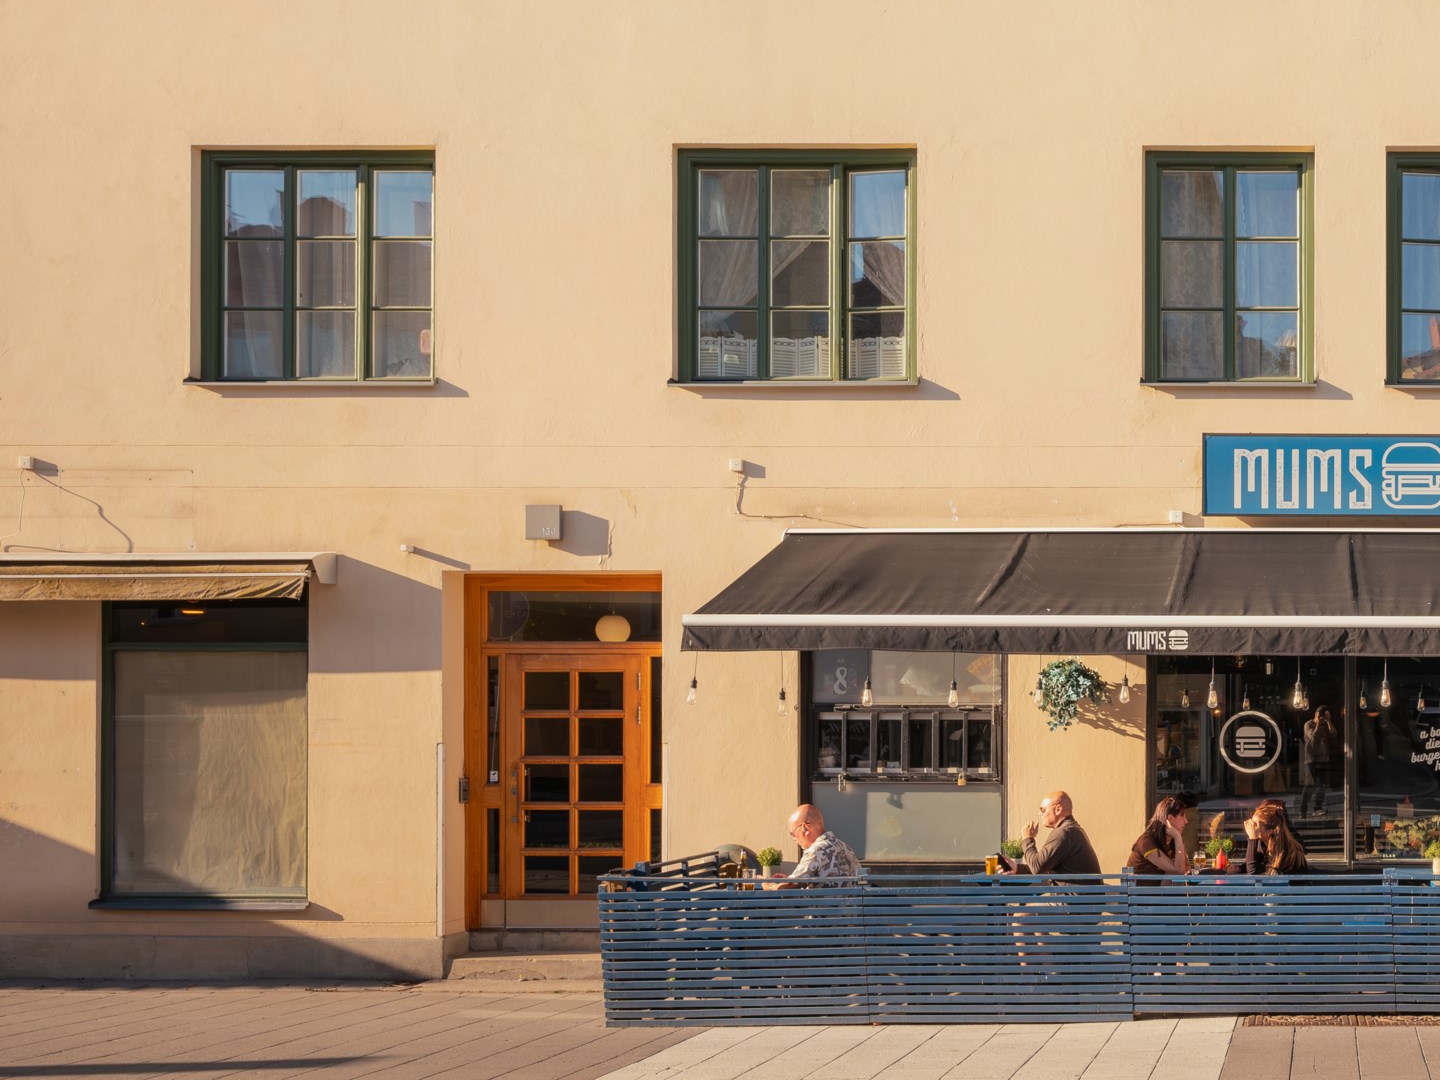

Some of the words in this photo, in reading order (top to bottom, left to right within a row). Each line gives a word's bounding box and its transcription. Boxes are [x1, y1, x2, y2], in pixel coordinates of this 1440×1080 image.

[1233, 448, 1373, 509] MUMS
[1127, 631, 1166, 650] MUMS
[1420, 730, 1429, 739] a
